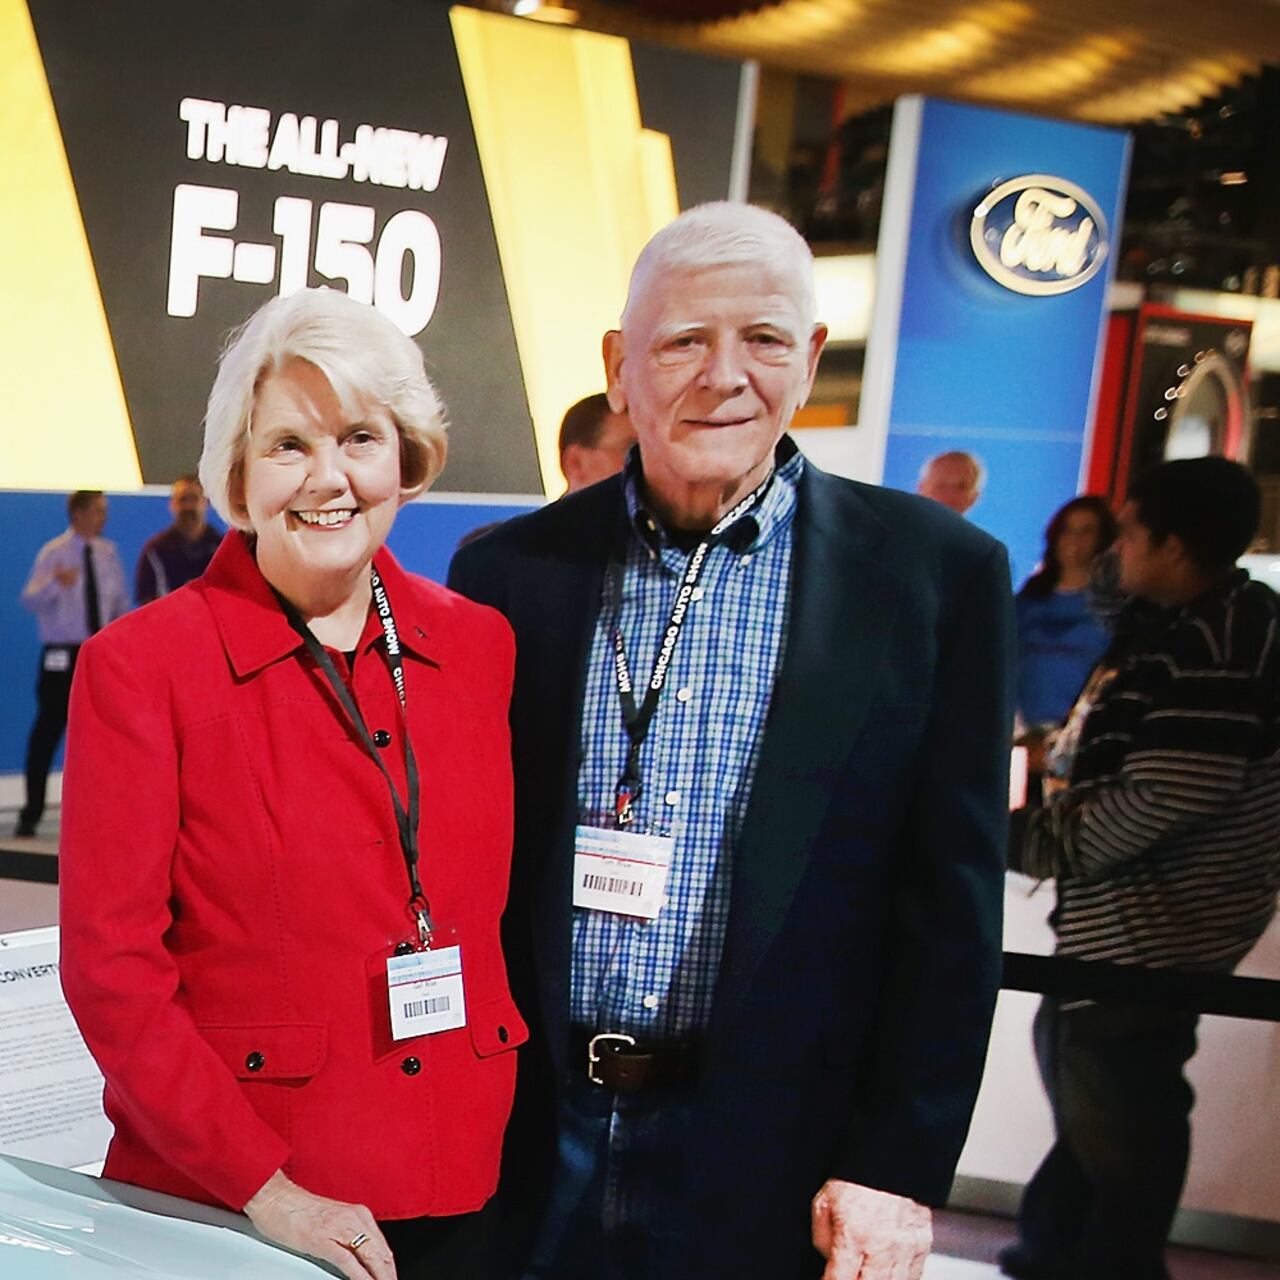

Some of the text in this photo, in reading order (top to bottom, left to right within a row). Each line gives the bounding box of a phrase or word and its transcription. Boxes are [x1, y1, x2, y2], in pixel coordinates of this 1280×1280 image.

[179, 97, 449, 192] THE ALL-NEW
[167, 183, 443, 338] F-150
[374, 587, 390, 617] AUTO
[382, 617, 400, 655] SHOW
[650, 542, 708, 690] CHICAGO AUTO SHOW
